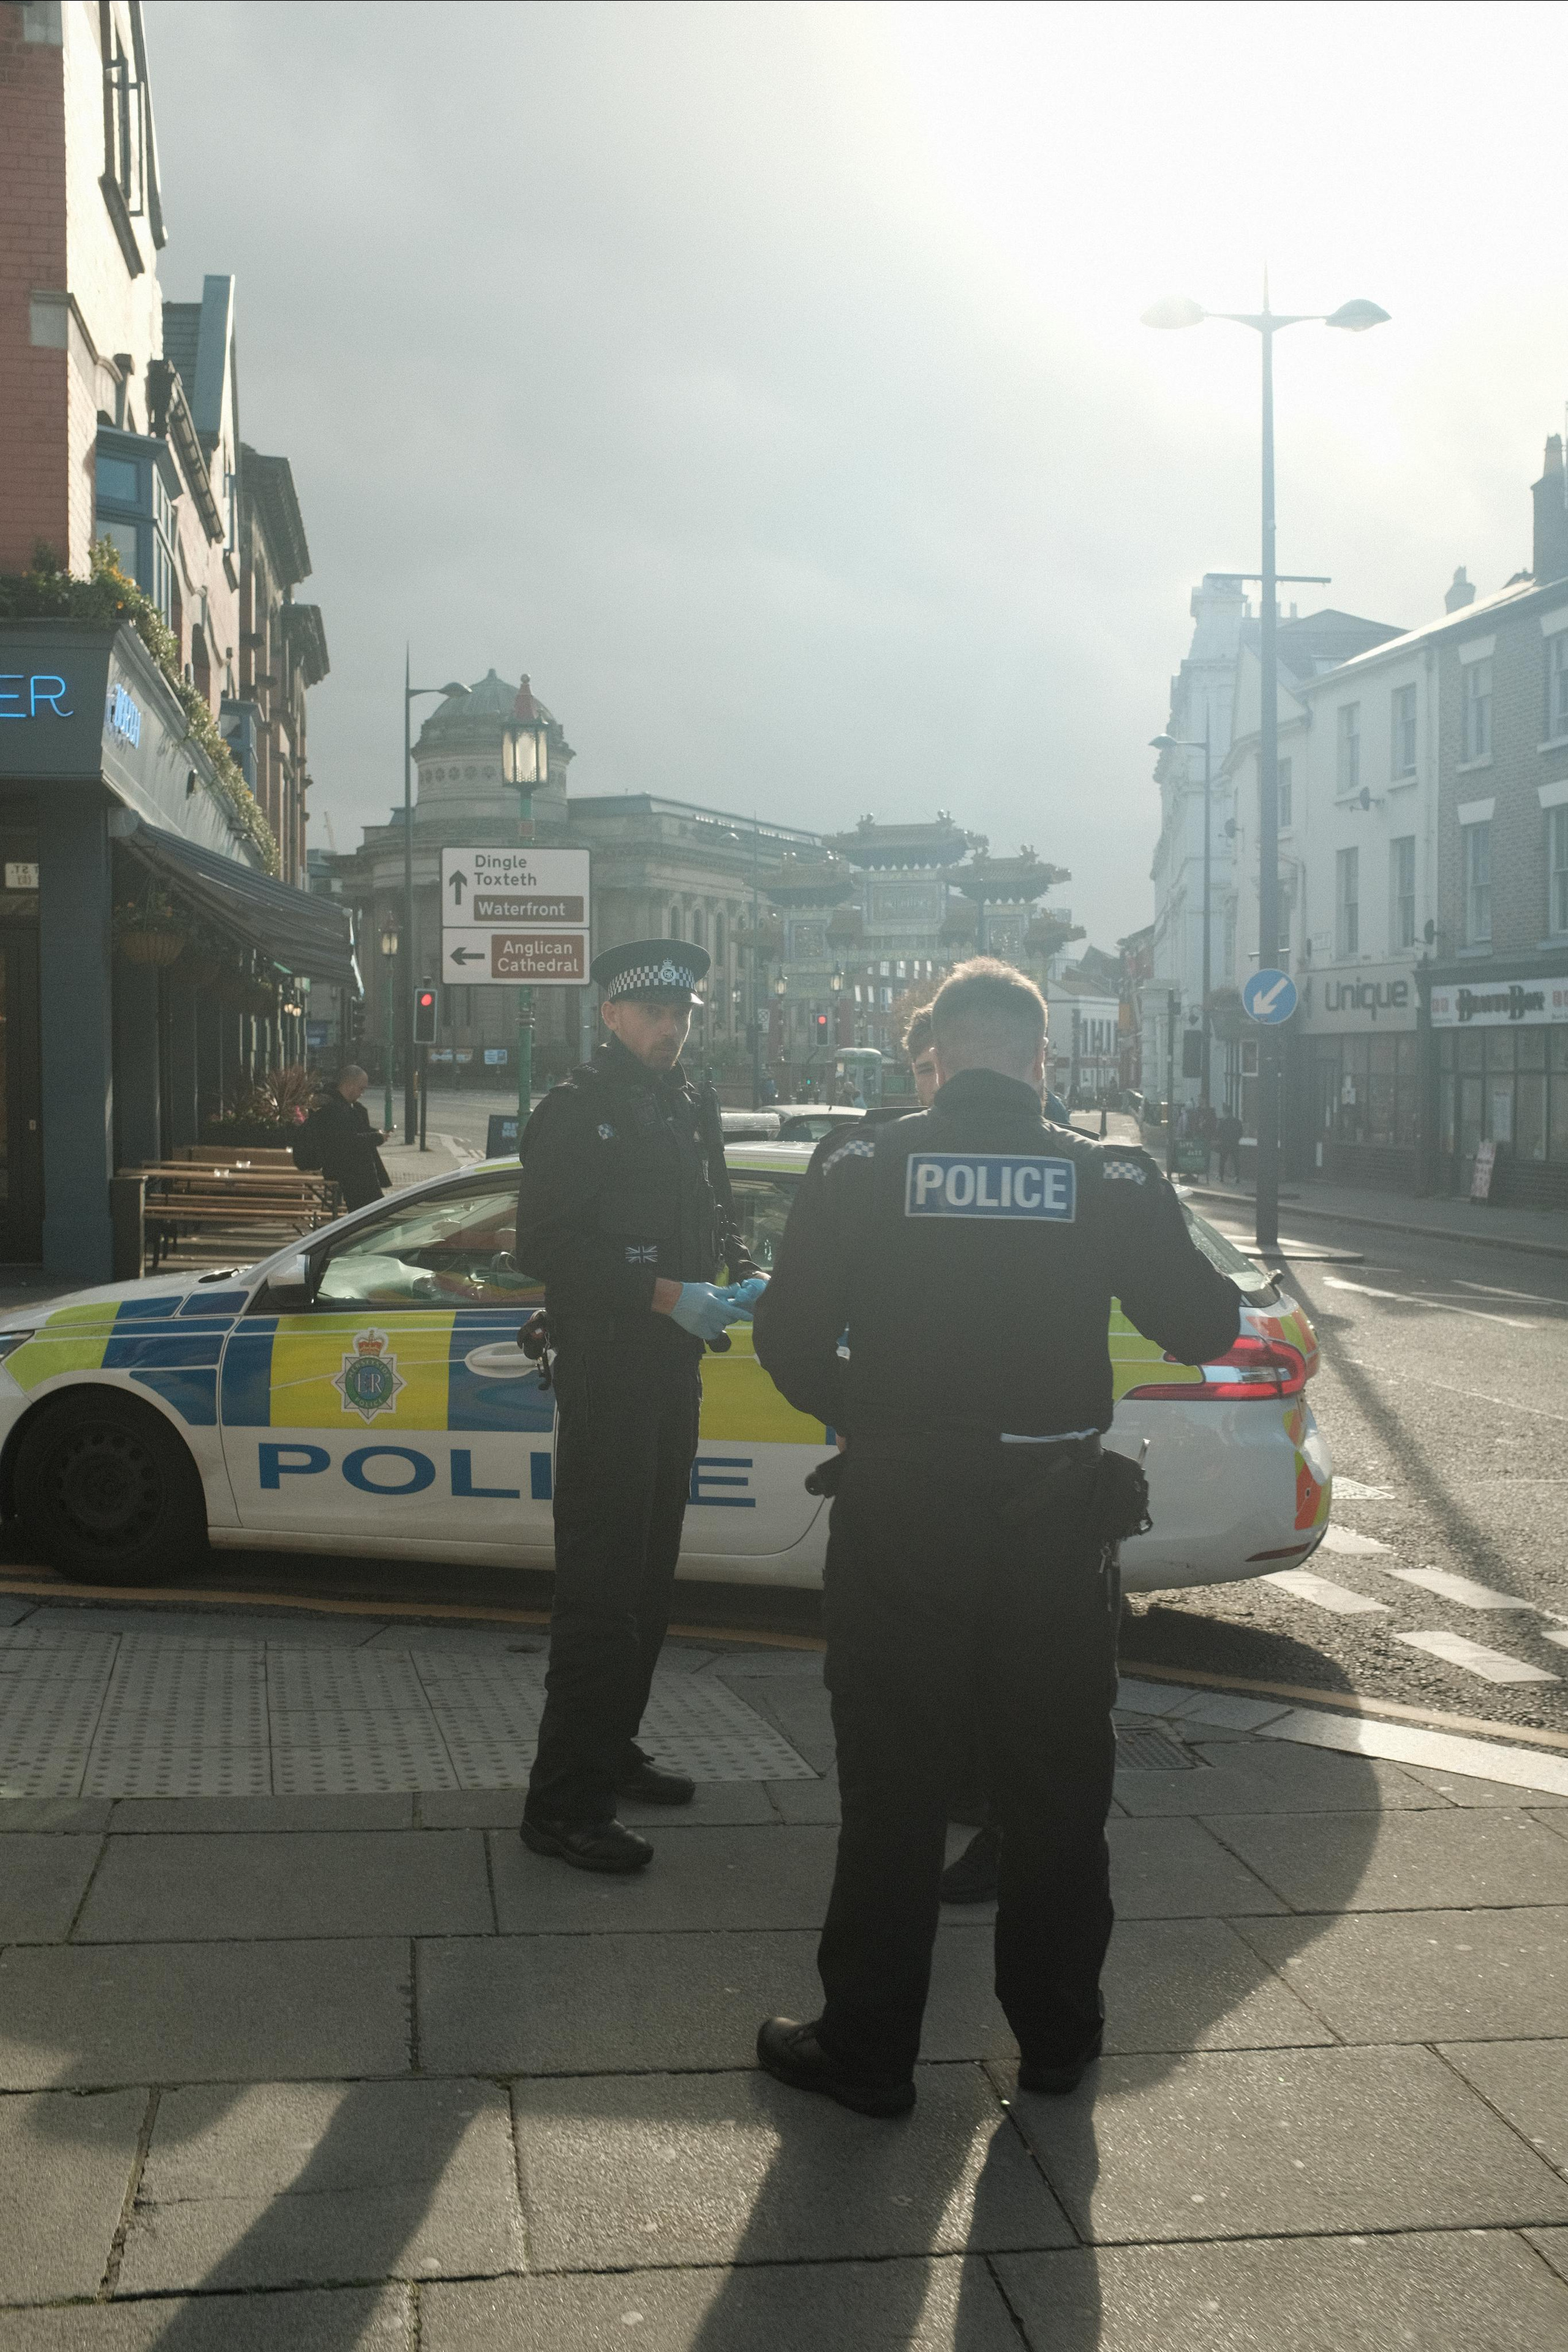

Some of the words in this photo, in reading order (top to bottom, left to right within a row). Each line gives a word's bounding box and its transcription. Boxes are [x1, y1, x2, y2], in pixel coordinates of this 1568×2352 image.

[475, 854, 527, 871] Dingle
[474, 872, 537, 886] Toxteth
[477, 901, 566, 916] Waterfront
[503, 940, 573, 957] Anglican
[497, 957, 579, 973] Cathedral
[1325, 976, 1408, 1021] Unique
[915, 1164, 1068, 1210] POLICE
[349, 1359, 391, 1379] MERSEYSIDE
[354, 1396, 383, 1408] POLICE
[258, 1442, 756, 1507] POLIE
